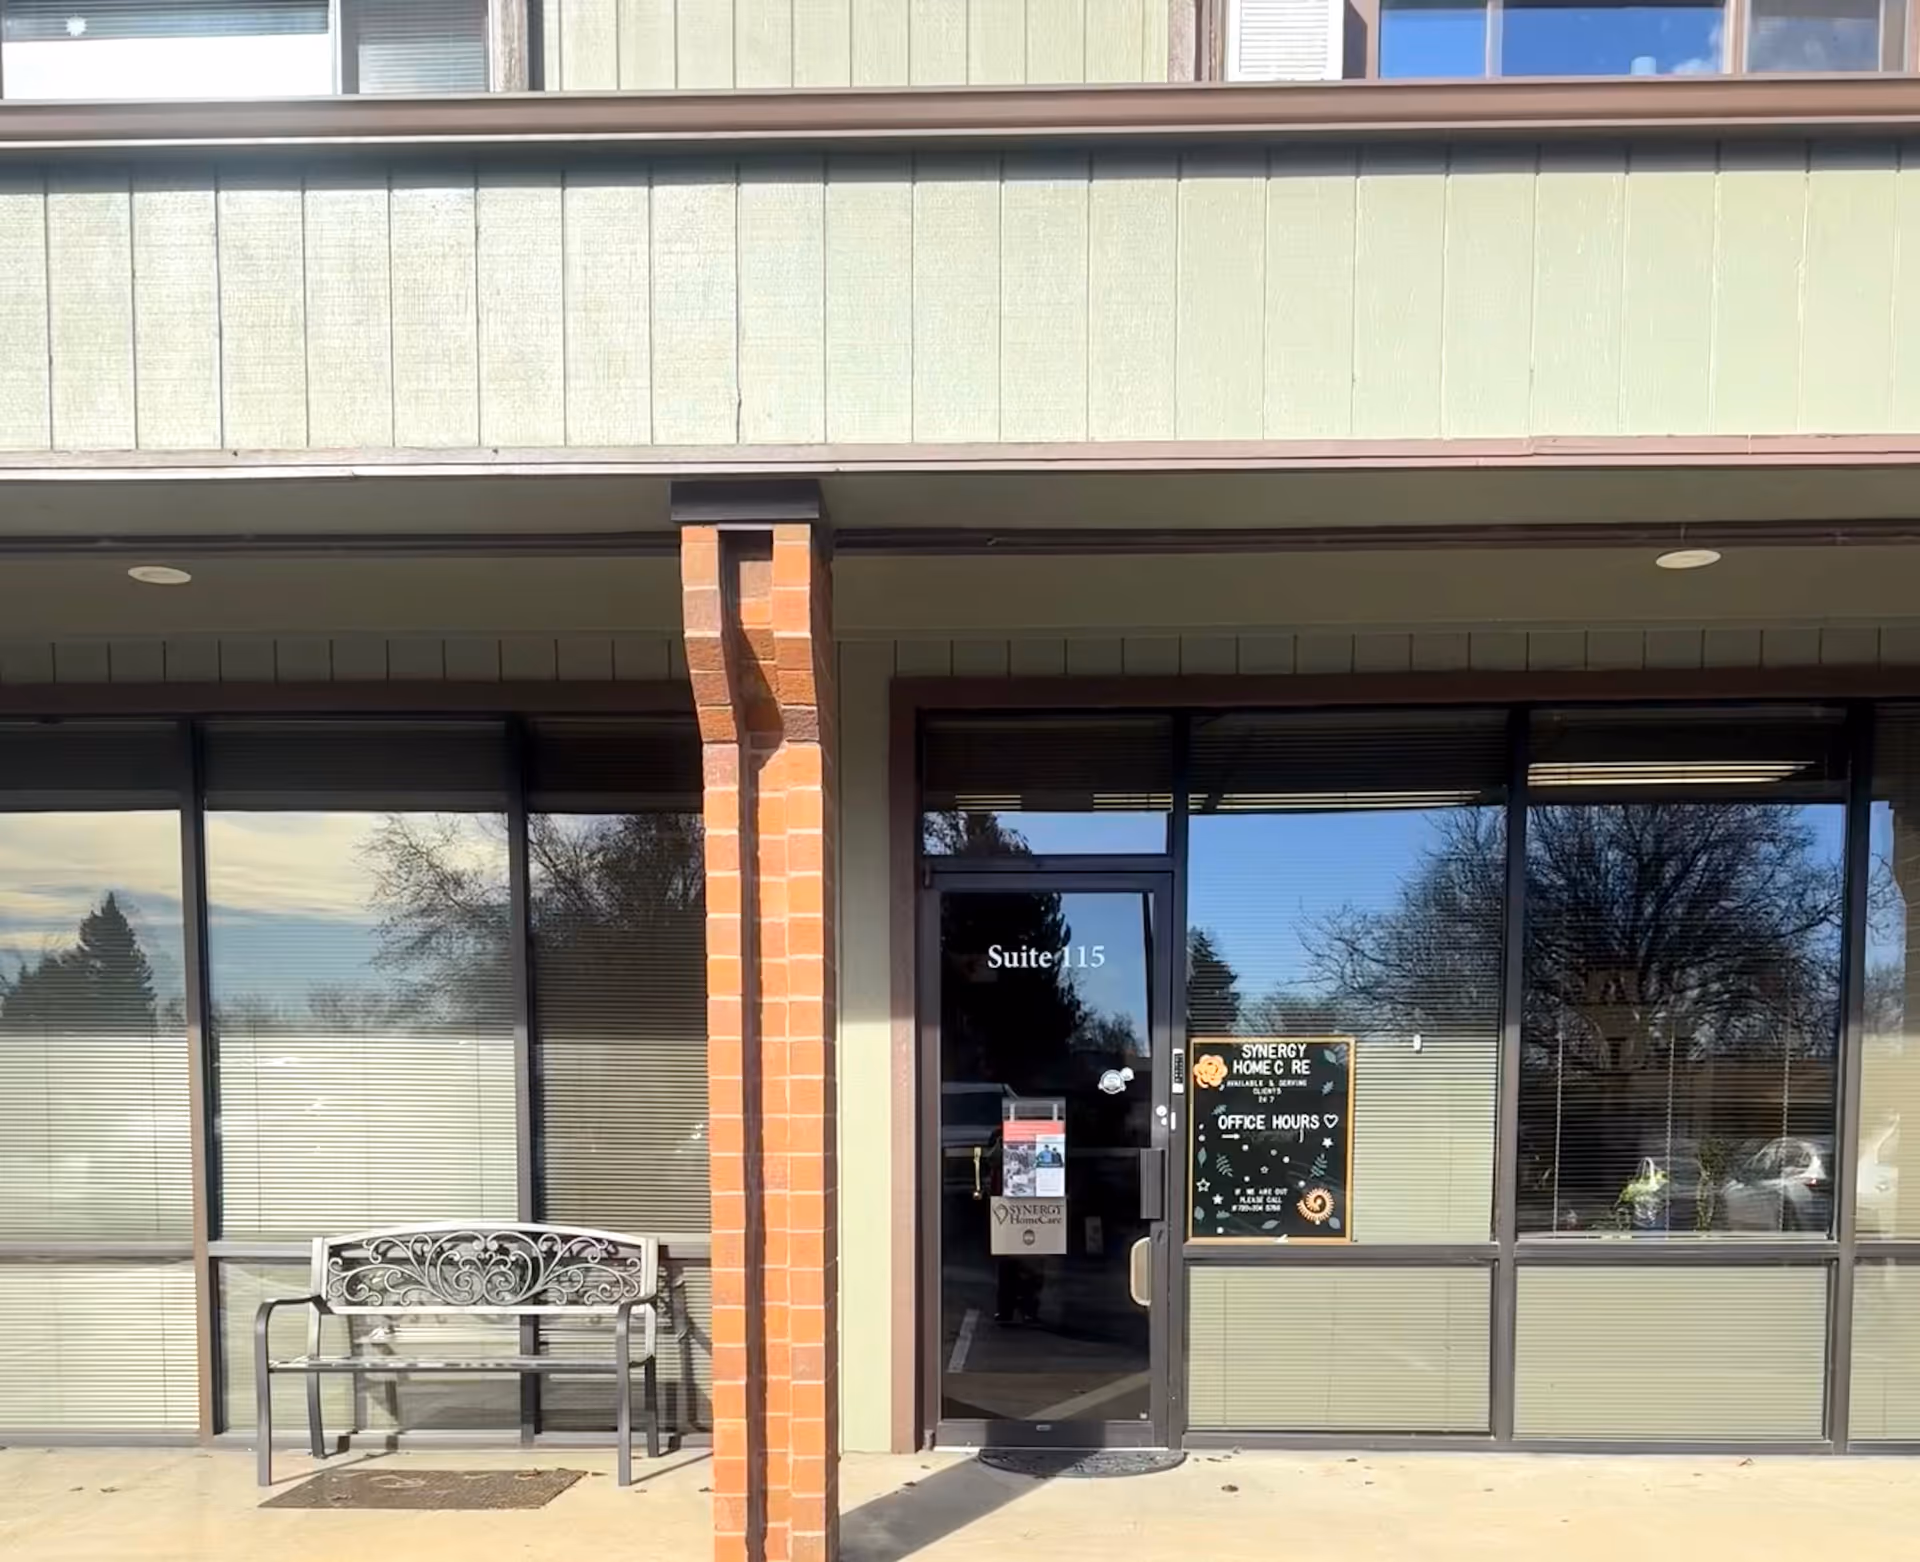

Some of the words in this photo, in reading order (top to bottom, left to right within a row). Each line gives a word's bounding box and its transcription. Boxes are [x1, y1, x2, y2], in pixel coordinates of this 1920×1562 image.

[987, 944, 1053, 968] Suite
[1061, 945, 1105, 968] 115
[1241, 1043, 1307, 1058] SYNERGY
[1217, 1114, 1266, 1130] OFFICE
[1272, 1114, 1320, 1130] HOURS
[1009, 1204, 1064, 1215] SYNERGY
[1010, 1214, 1062, 1224] HomeCare
